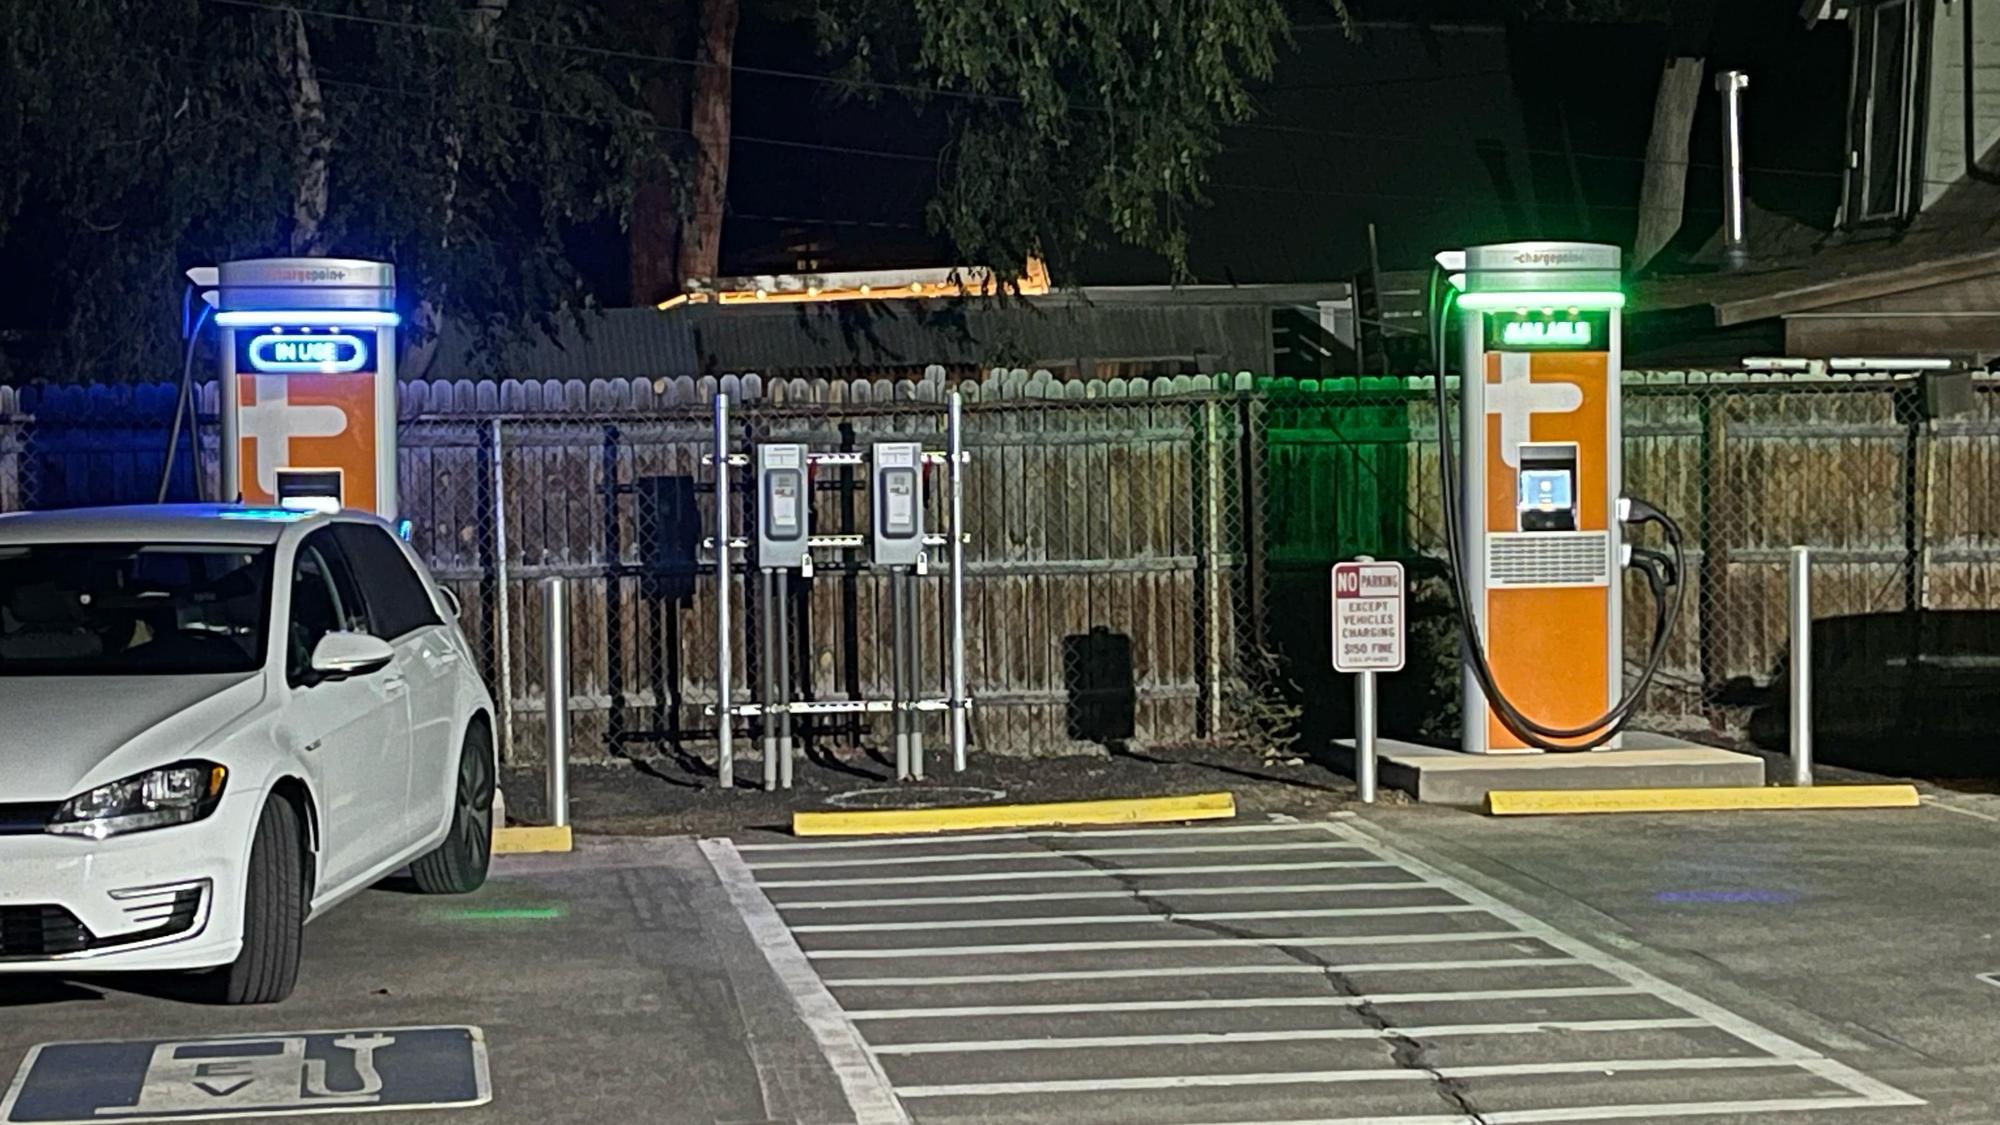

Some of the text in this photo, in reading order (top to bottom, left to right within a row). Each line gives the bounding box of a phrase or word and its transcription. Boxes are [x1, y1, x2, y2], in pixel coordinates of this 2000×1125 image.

[275, 342, 296, 361] IN
[1338, 572, 1398, 592] NO PANG
[1348, 601, 1389, 613] EXCEPT
[1343, 614, 1394, 625] VEHICLES
[1342, 627, 1395, 639] CHARGING
[1344, 643, 1367, 655] $150
